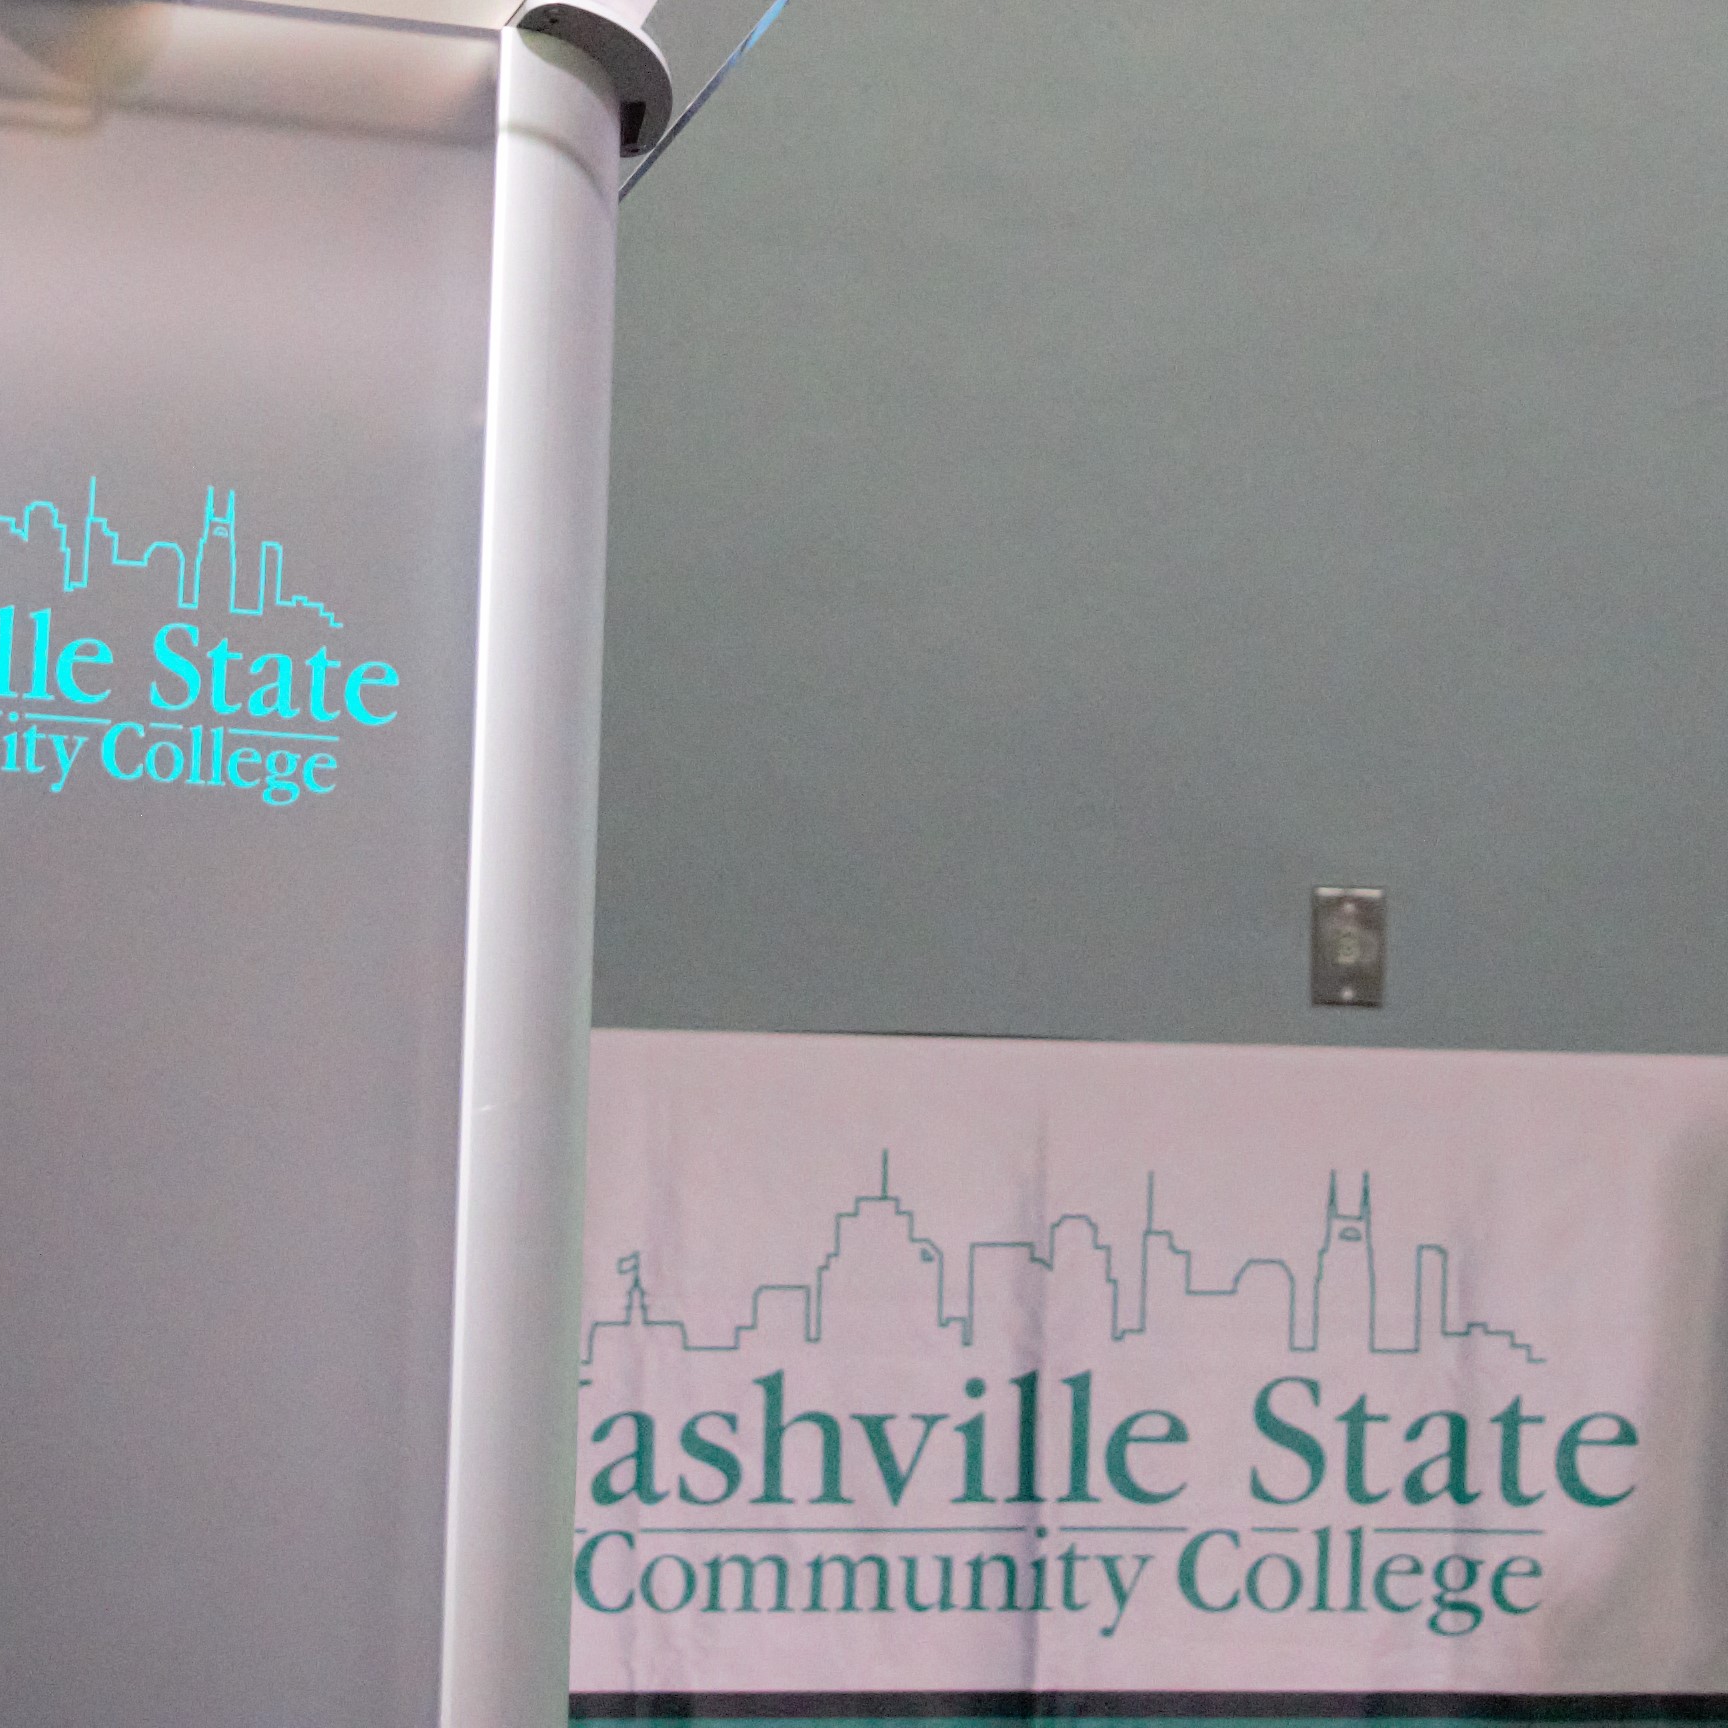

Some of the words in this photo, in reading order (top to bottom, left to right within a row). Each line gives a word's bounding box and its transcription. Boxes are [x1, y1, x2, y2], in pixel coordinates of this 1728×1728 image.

[148, 621, 401, 728] State
[99, 719, 339, 808] College
[575, 1369, 1189, 1509] ashville
[1249, 1375, 1640, 1509] State
[571, 1526, 1152, 1638] Community
[1176, 1527, 1545, 1638] College
